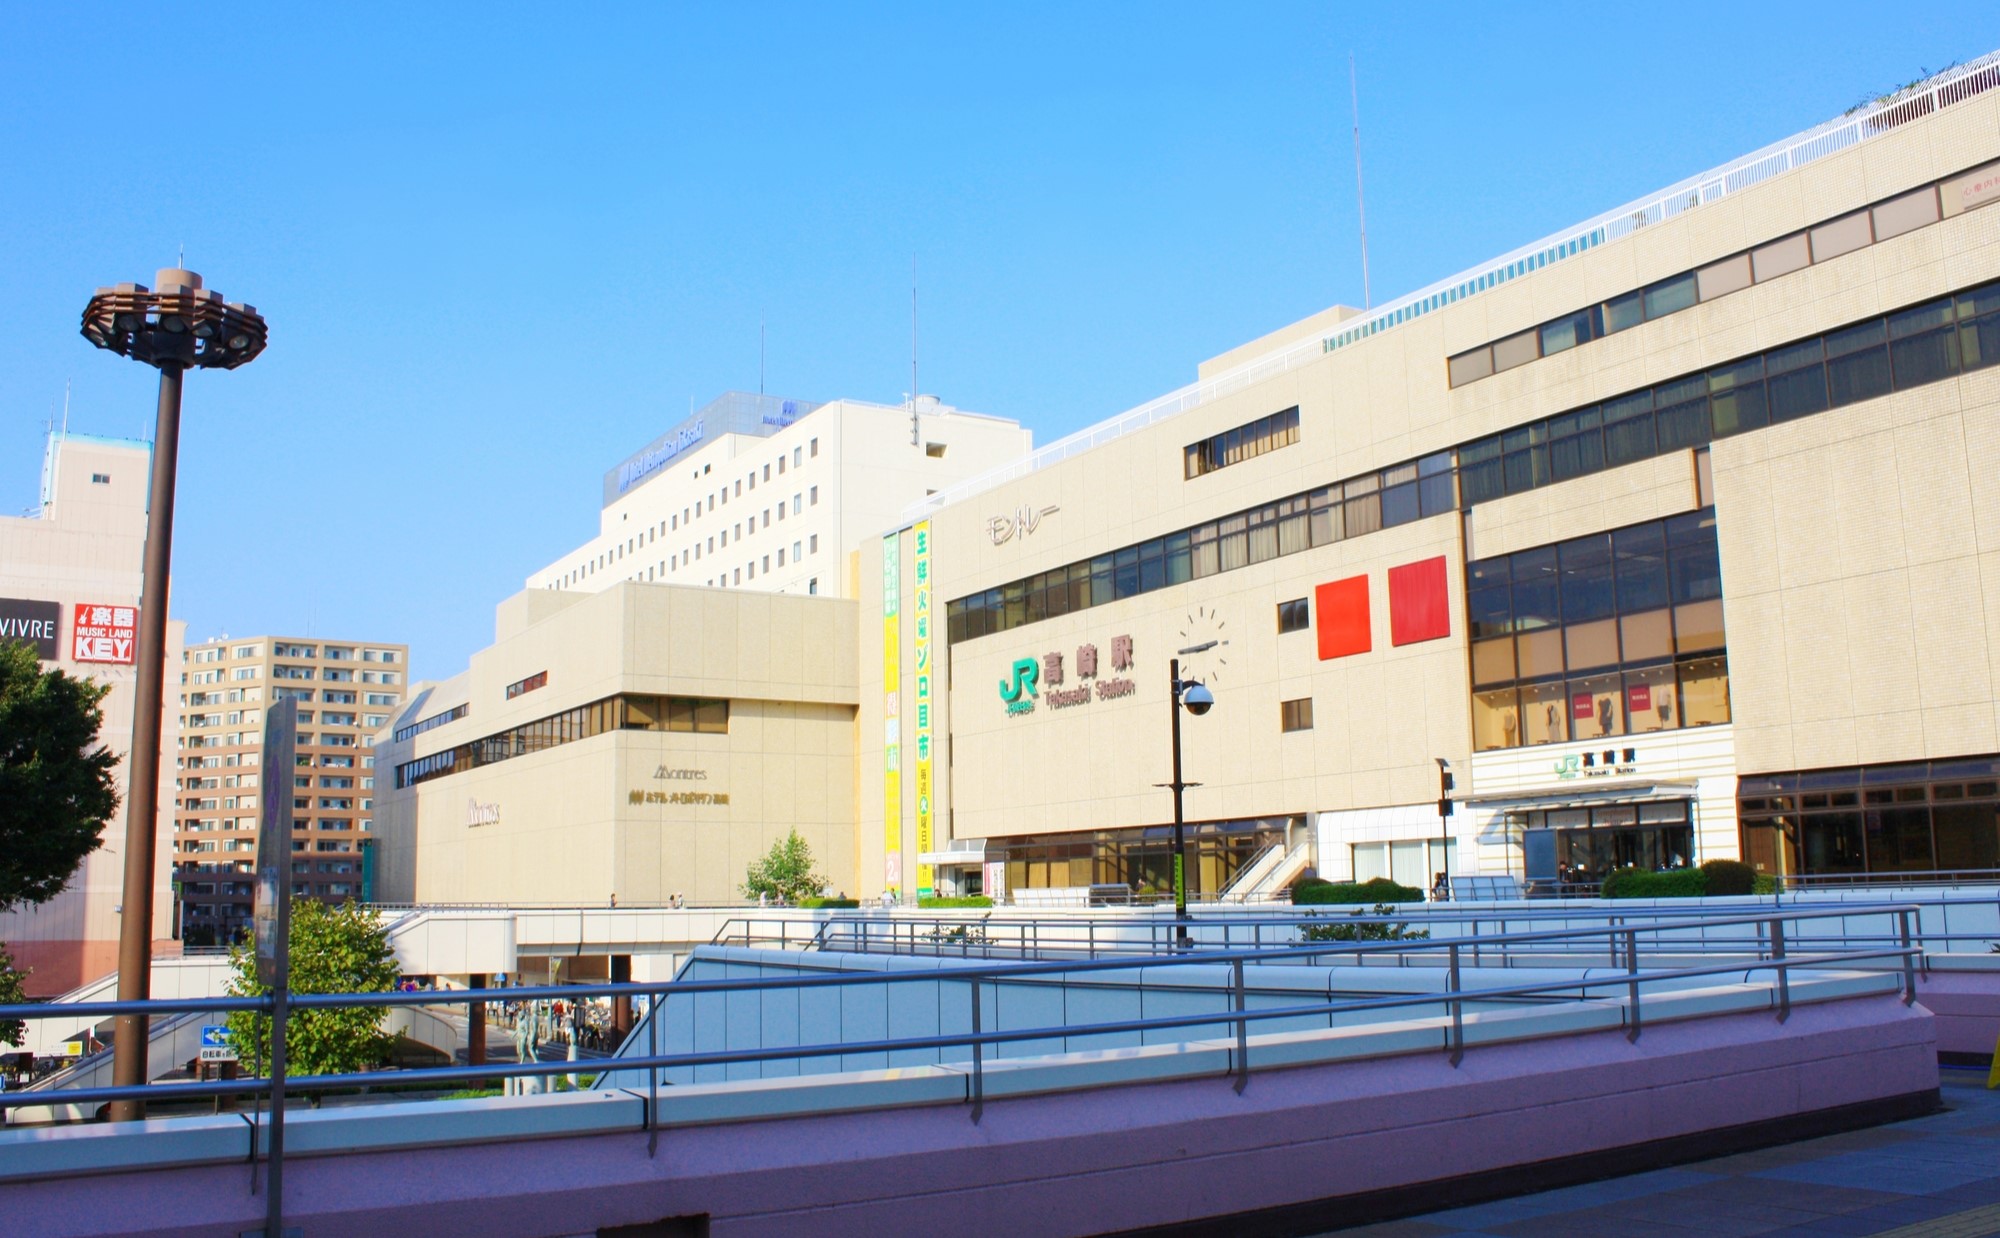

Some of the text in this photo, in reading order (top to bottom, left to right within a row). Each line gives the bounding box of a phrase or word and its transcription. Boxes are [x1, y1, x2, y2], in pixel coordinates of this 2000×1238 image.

[0, 618, 54, 639] VIVRE
[91, 607, 134, 627] 楽器
[76, 627, 133, 639] MUSIC LAND
[75, 637, 132, 662] KEY
[1043, 634, 1134, 685] 高崎駅
[999, 657, 1039, 701] JR
[1044, 678, 1134, 708] Takasaki Station
[1554, 754, 1579, 773] JR
